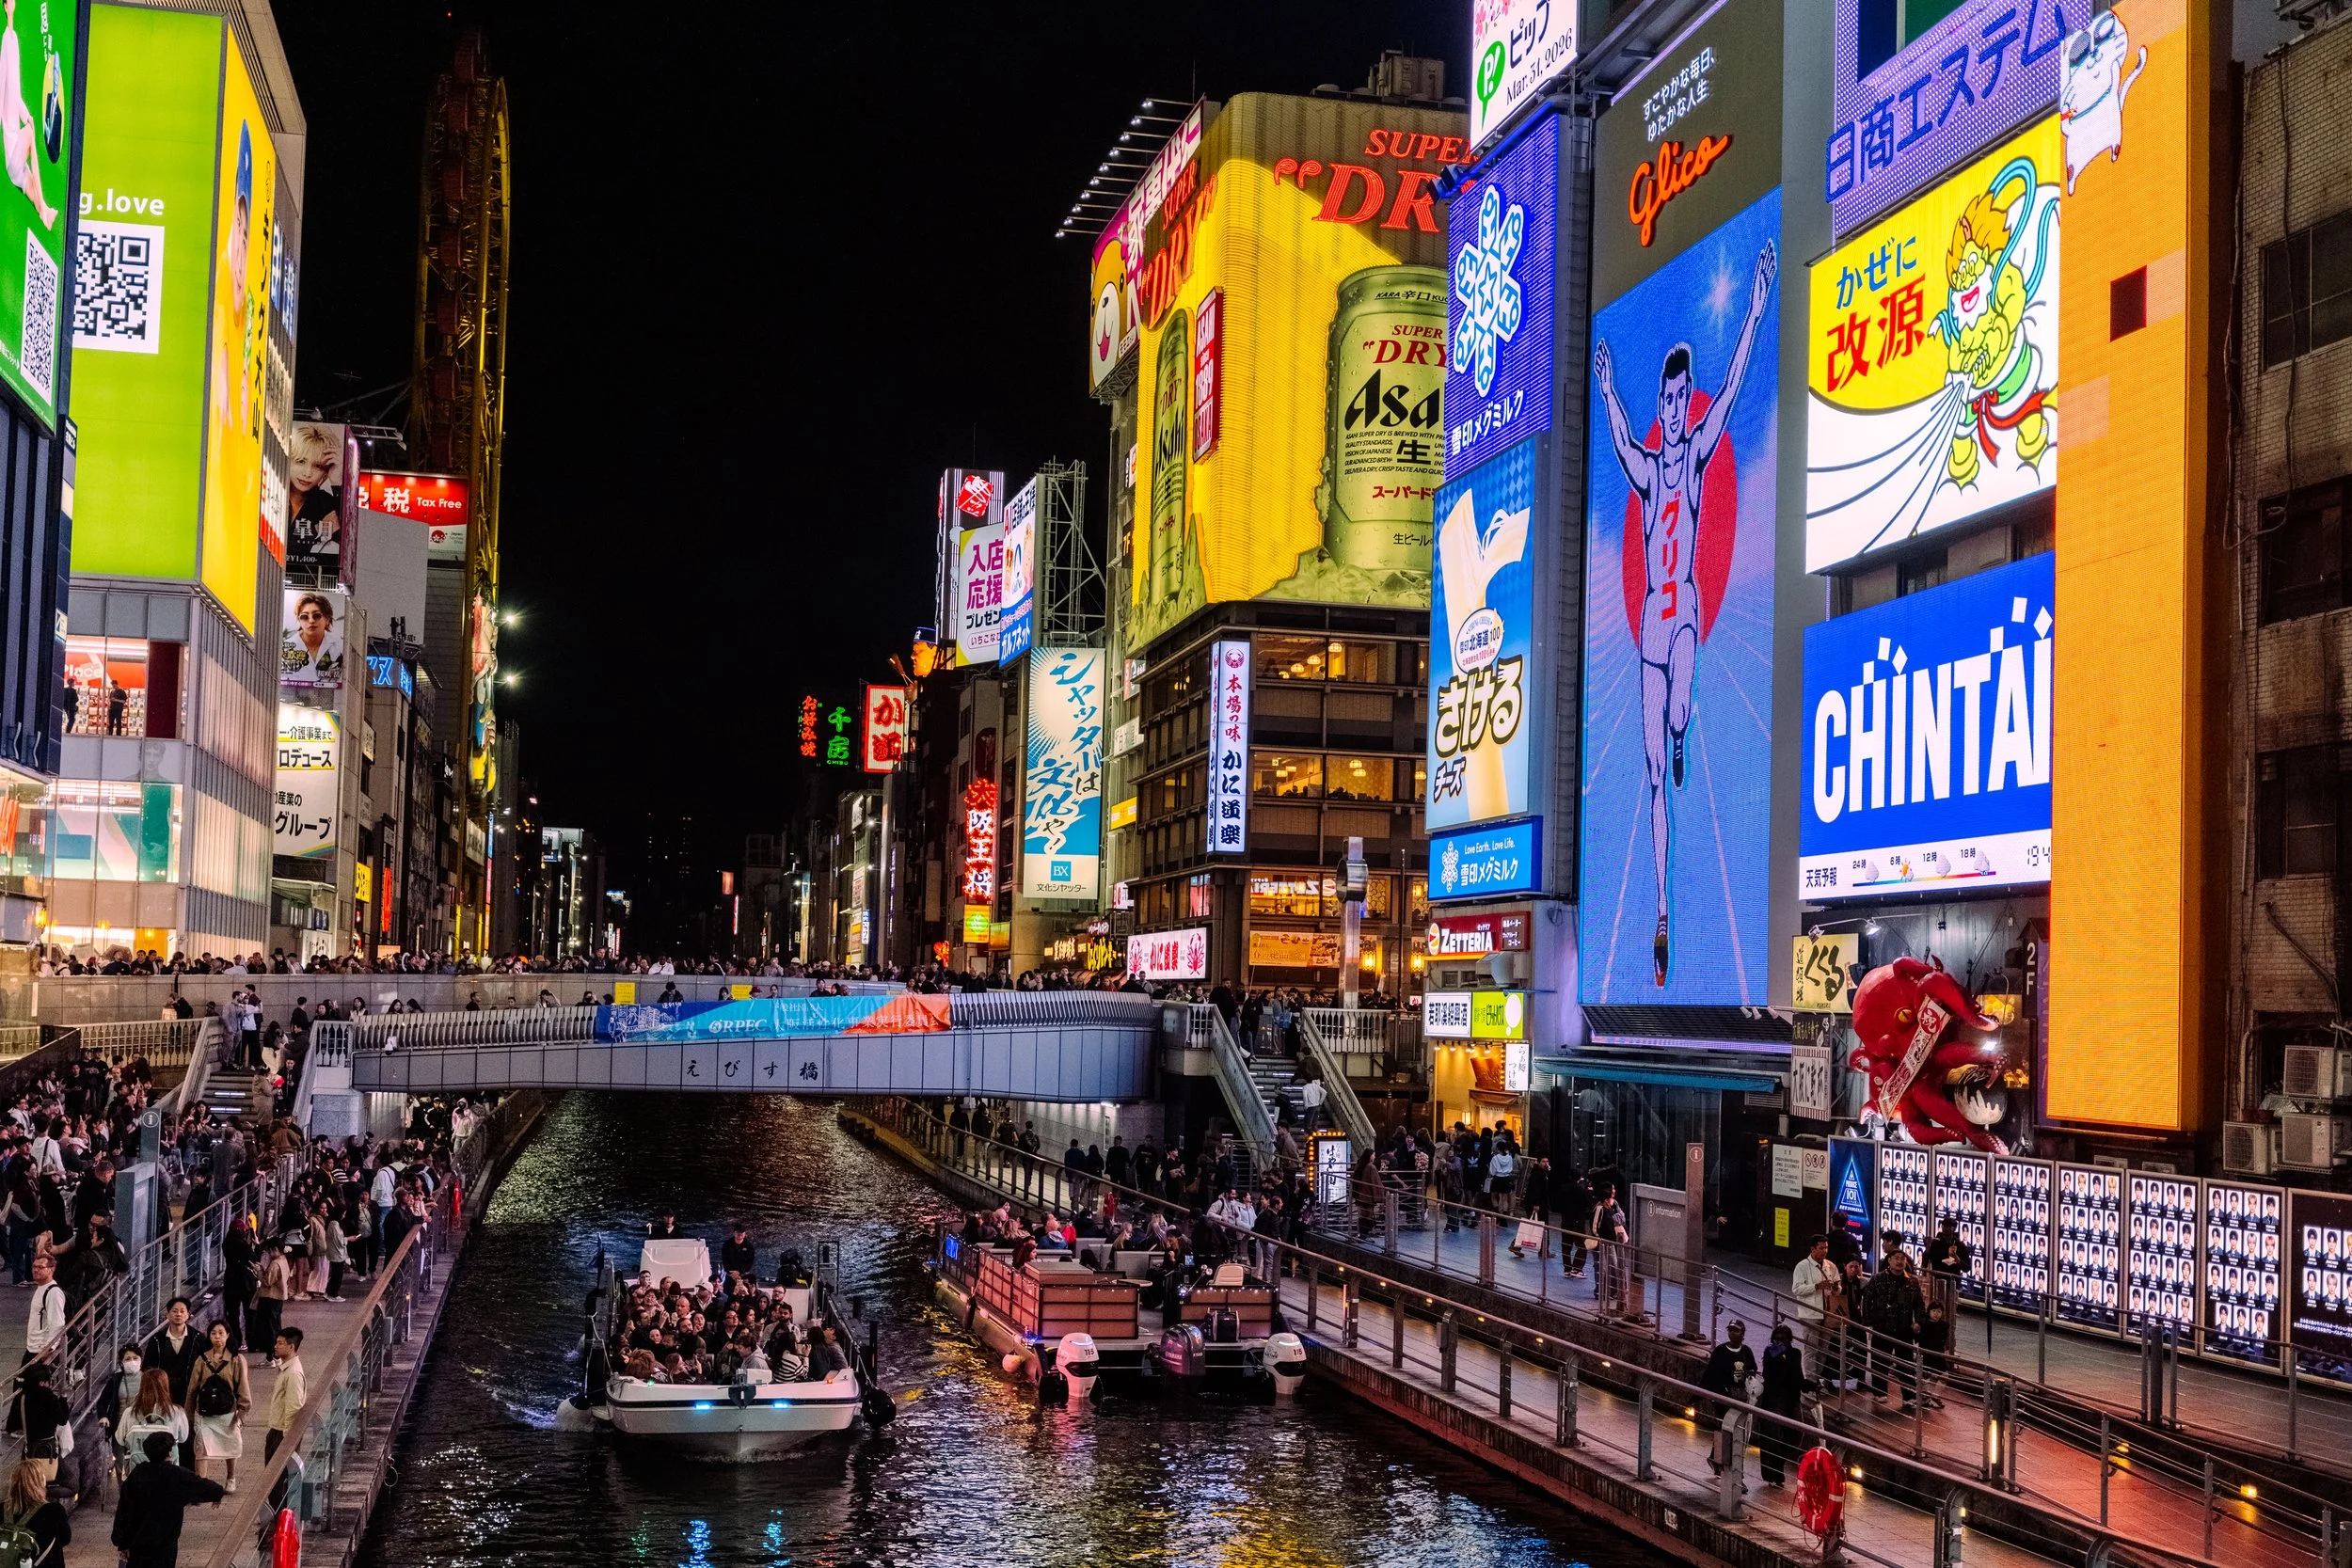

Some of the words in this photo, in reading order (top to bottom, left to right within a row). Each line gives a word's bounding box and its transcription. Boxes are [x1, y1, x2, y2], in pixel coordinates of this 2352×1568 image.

[1509, 0, 1550, 69] ピップ
[1506, 74, 1529, 106] Mar.
[1529, 56, 1544, 85] 31,
[1544, 27, 1572, 70] 2026
[1643, 47, 1718, 120] すこやかな毎日、
[1825, 0, 2068, 203] 日商エステム
[1163, 158, 1198, 232] SUPER
[1629, 134, 1733, 247] Glico
[1401, 290, 1431, 301] 辛口
[1836, 235, 1918, 310] かぜに
[1391, 325, 1444, 340] SUPER
[1826, 273, 1927, 394] 改源
[1196, 358, 1216, 409] 1889
[1343, 368, 1446, 431] Asa
[1154, 404, 1185, 483] Asahi
[1451, 388, 1524, 456] 雪印メグミルク
[1396, 439, 1432, 465] 生
[417, 497, 437, 508] Tax
[438, 498, 463, 509] Free
[967, 539, 1004, 577] 入店
[1392, 533, 1431, 546] 生ビール
[1661, 490, 1682, 621] グリコ
[966, 572, 1003, 610] 応援
[800, 695, 818, 757] お好み焼
[1224, 673, 1244, 743] 本場の味
[1436, 656, 1523, 757] さける
[1813, 626, 2052, 824] CHINTAI
[828, 705, 852, 760] 千房
[1220, 749, 1243, 846] かに道楽
[1434, 756, 1467, 804] チーズ
[275, 810, 333, 840] グループ
[961, 778, 999, 901] 大阪王将
[1464, 845, 1476, 854] Love
[1475, 841, 1491, 853] Earth.
[1492, 839, 1504, 851] Love
[1504, 836, 1516, 848] Life.
[1053, 865, 1070, 877] BX
[1460, 856, 1518, 886] 雪印メグミルク
[1805, 866, 1838, 888] 天気予報
[1851, 859, 1867, 870] 24時
[1890, 855, 1901, 866] 6時
[1922, 851, 1938, 863] 12時
[1961, 847, 1977, 859] 18時
[1440, 927, 1493, 954] ZETTERIA
[1804, 944, 1845, 1002] くくる
[2026, 942, 2036, 996] 2F
[686, 1059, 819, 1082] えびす橋
[1846, 1189, 1857, 1201] 101
[1084, 1348, 1095, 1356] 115
[1293, 1348, 1303, 1356] 115
